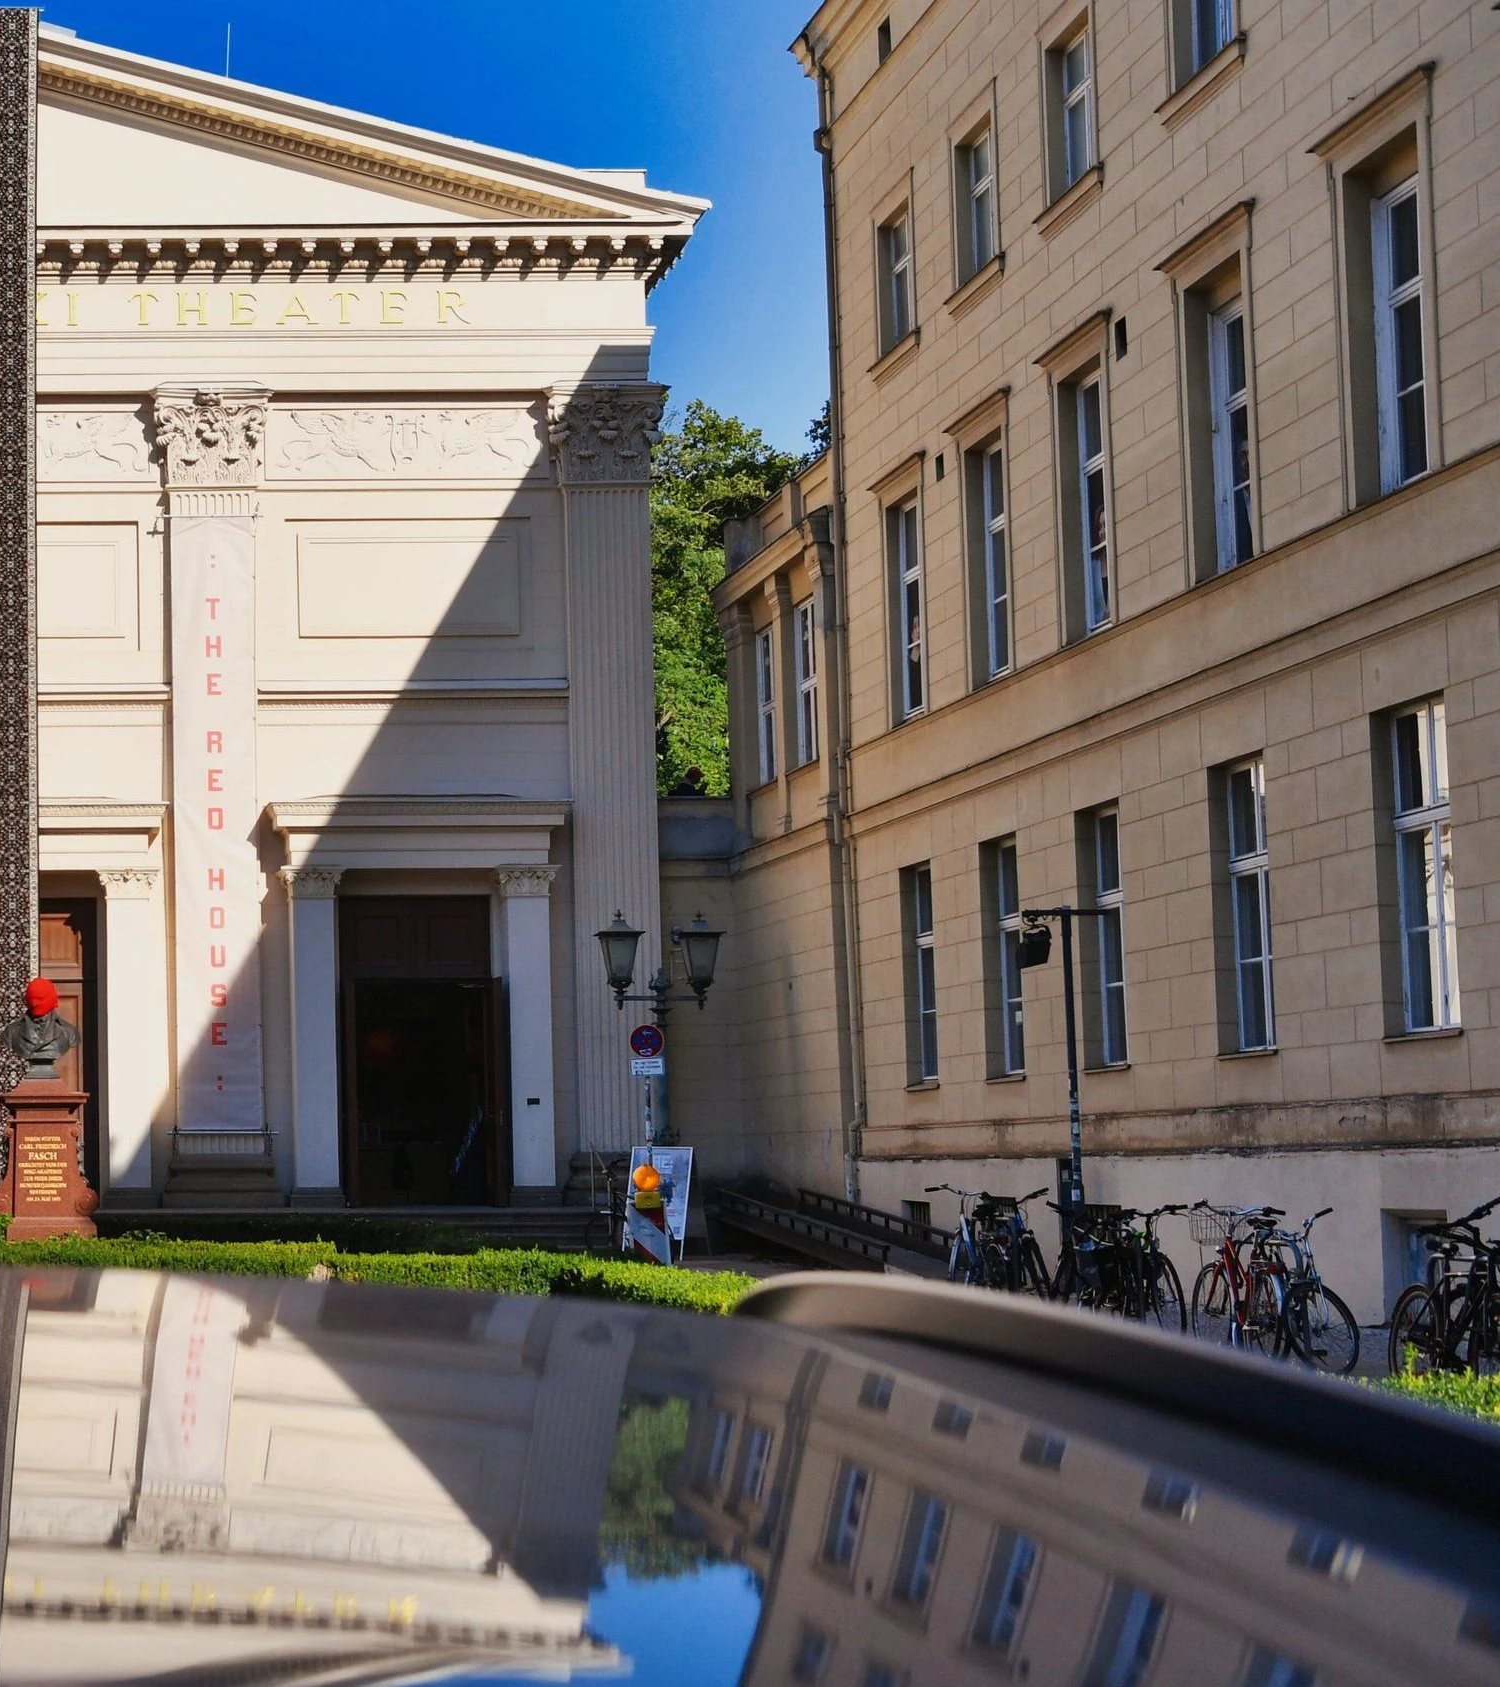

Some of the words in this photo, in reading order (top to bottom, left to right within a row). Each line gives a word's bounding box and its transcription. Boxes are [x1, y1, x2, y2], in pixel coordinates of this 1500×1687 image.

[128, 290, 471, 326] THEATER
[206, 731, 224, 830] RED
[28, 1152, 58, 1160] FASCH
